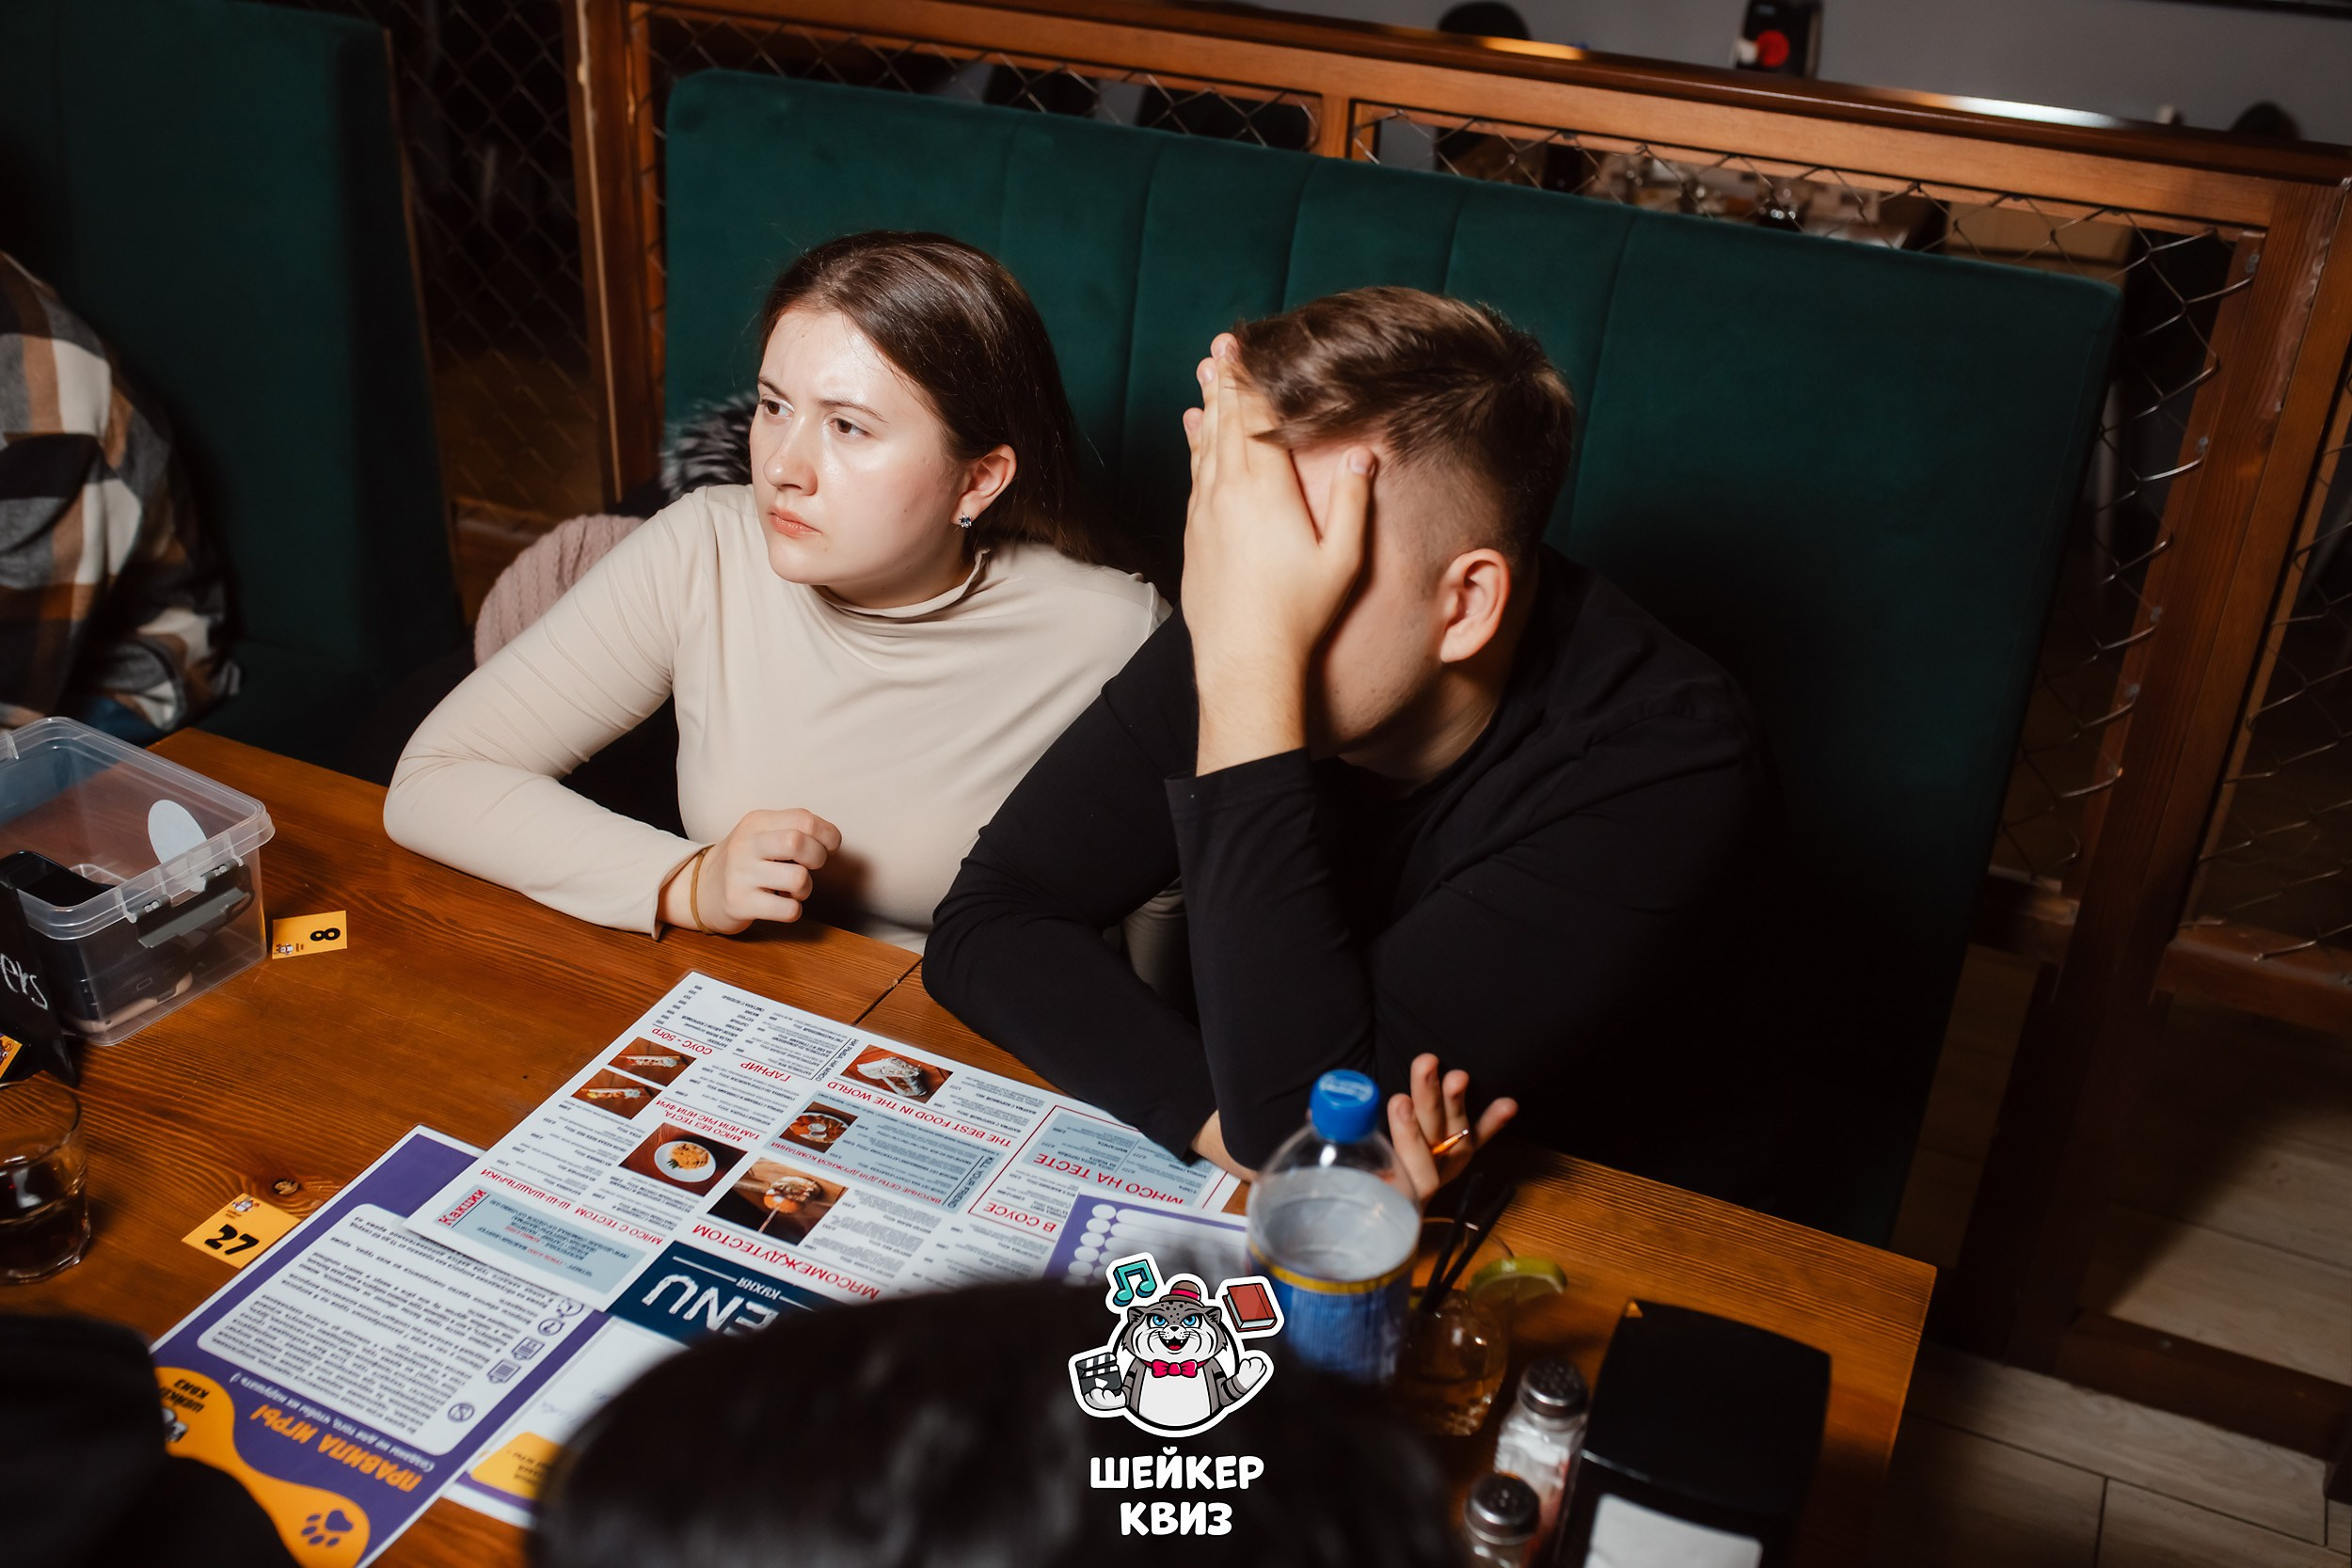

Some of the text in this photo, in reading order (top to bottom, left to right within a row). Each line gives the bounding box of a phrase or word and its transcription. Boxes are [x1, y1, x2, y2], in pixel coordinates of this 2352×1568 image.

[309, 927, 341, 942] 8
[651, 1028, 676, 1041] 50гр
[681, 1039, 713, 1055] СОУС
[739, 1061, 791, 1082] ГАРНИР
[655, 1099, 760, 1139] ТАМ ИЛИ РИС ИЛИ ФРИ
[826, 1081, 1011, 1147] THE BEST FOOD IN THE WORLD
[664, 1109, 742, 1141] МЯСО БЕЗ ТЕСТА,
[1033, 1152, 1090, 1179] ТЕСТЕ
[877, 1179, 901, 1190] СЕТЫ
[1097, 1172, 1123, 1188] НА
[903, 1187, 942, 1204] ВКУСНЫЕ
[574, 1207, 618, 1227] ТЕСТОМ
[983, 1203, 1057, 1232] В СОУСЕ
[618, 1224, 629, 1232] С
[628, 1228, 663, 1244] МЯСО
[203, 1223, 260, 1256] 27
[691, 1224, 882, 1300] МЯСОМЕЖДУТЕСТОМ
[735, 1276, 781, 1300] КУХНЯ
[642, 1273, 780, 1336] ENU
[173, 1379, 209, 1399] КВИЗ
[249, 1403, 422, 1492] ПРАВИЛА ИГРЫ
